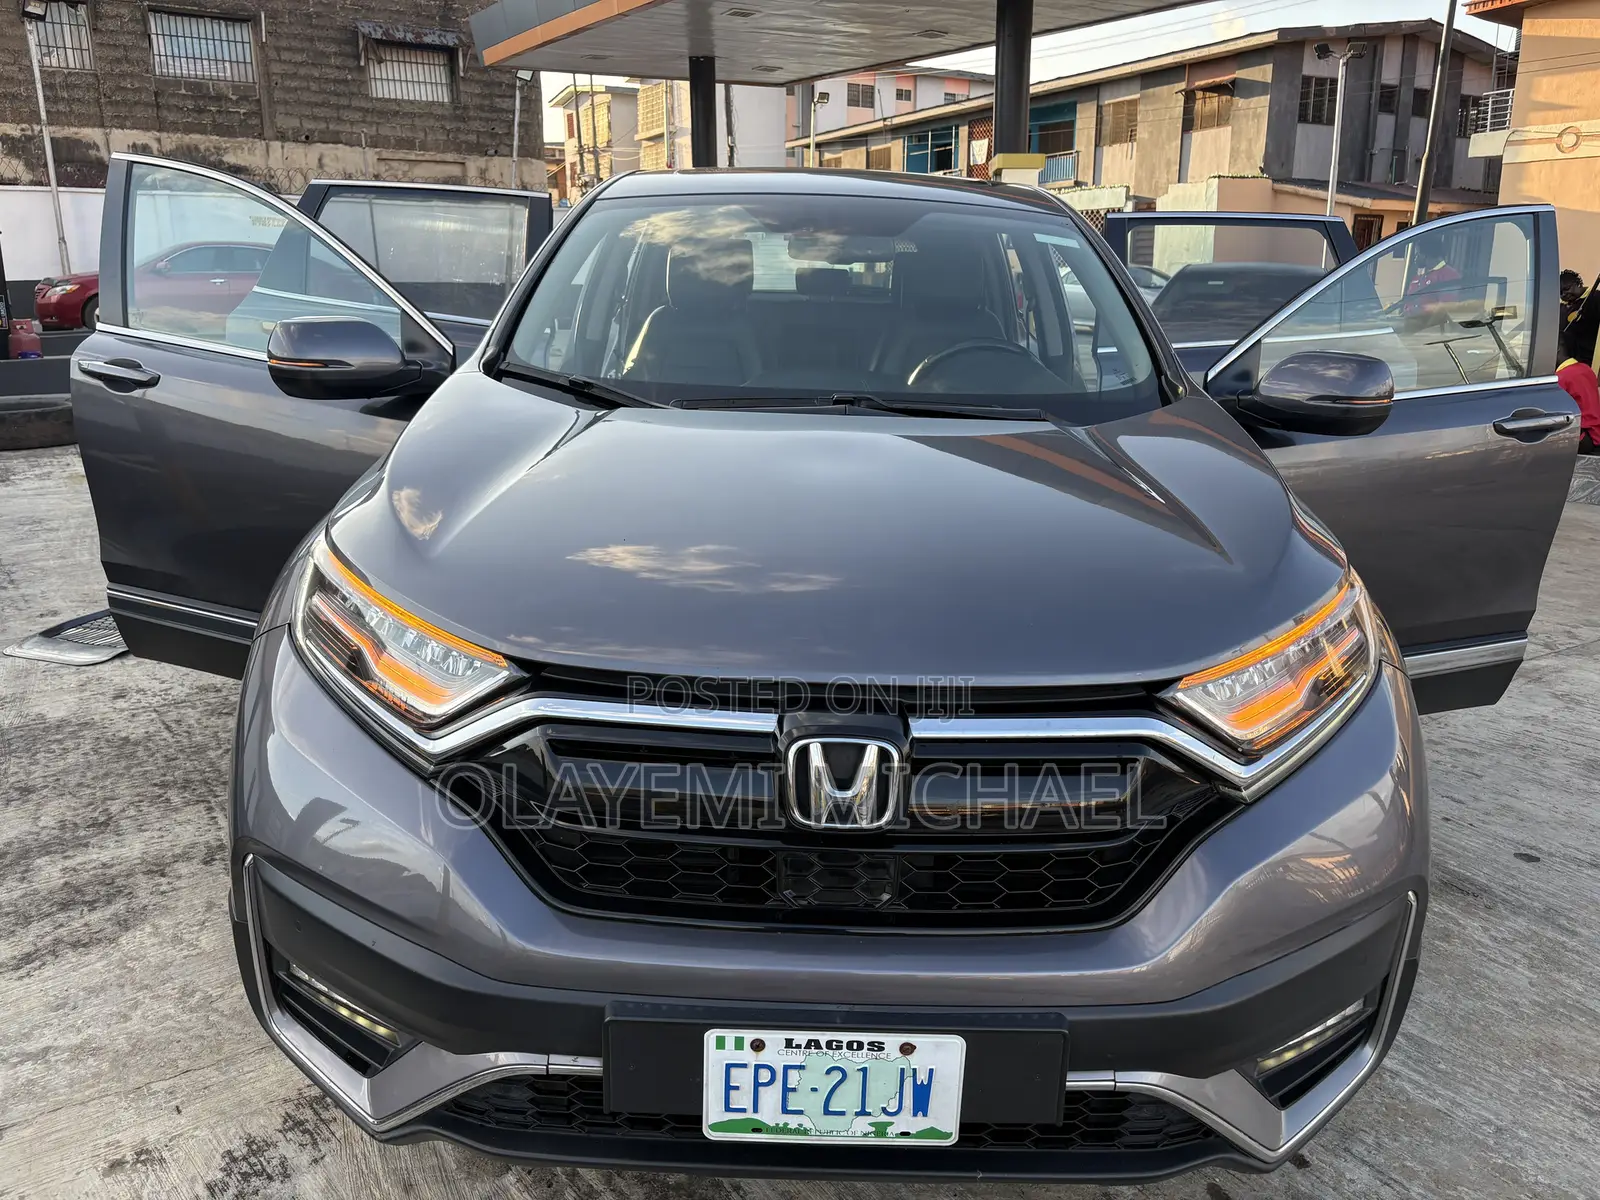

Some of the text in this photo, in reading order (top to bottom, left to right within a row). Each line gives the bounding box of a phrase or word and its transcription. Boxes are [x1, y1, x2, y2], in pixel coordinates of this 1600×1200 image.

[783, 1037, 886, 1052] LAGOS
[777, 1049, 812, 1057] CENTRE
[832, 1051, 892, 1060] EXCELLENCE
[724, 1062, 935, 1117] EPE-21JW
